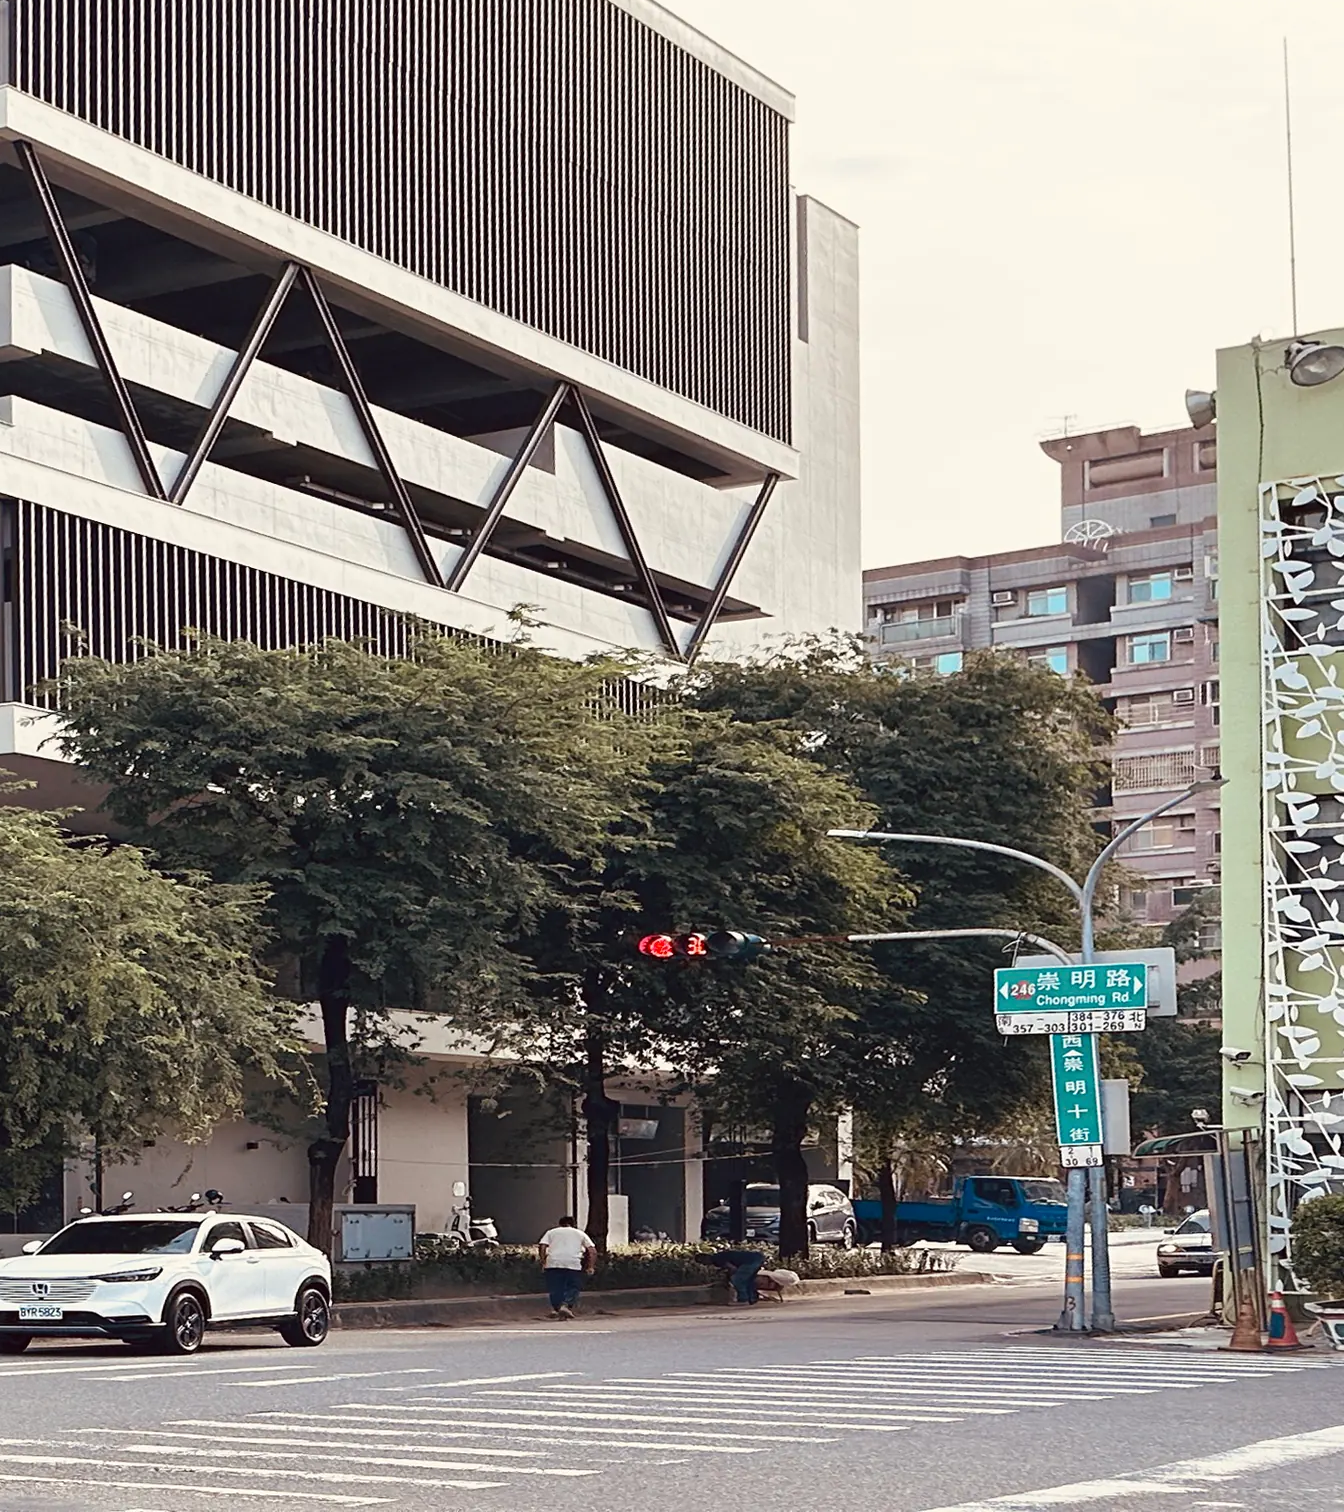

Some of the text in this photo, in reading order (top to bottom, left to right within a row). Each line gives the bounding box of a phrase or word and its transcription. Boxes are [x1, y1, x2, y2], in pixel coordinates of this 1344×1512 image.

[1037, 969, 1131, 990] 崇明路
[1010, 982, 1036, 996] 246
[1036, 993, 1106, 1007] Chongming
[1128, 1011, 1144, 1022] 北
[1063, 1057, 1090, 1142] 崇明十街
